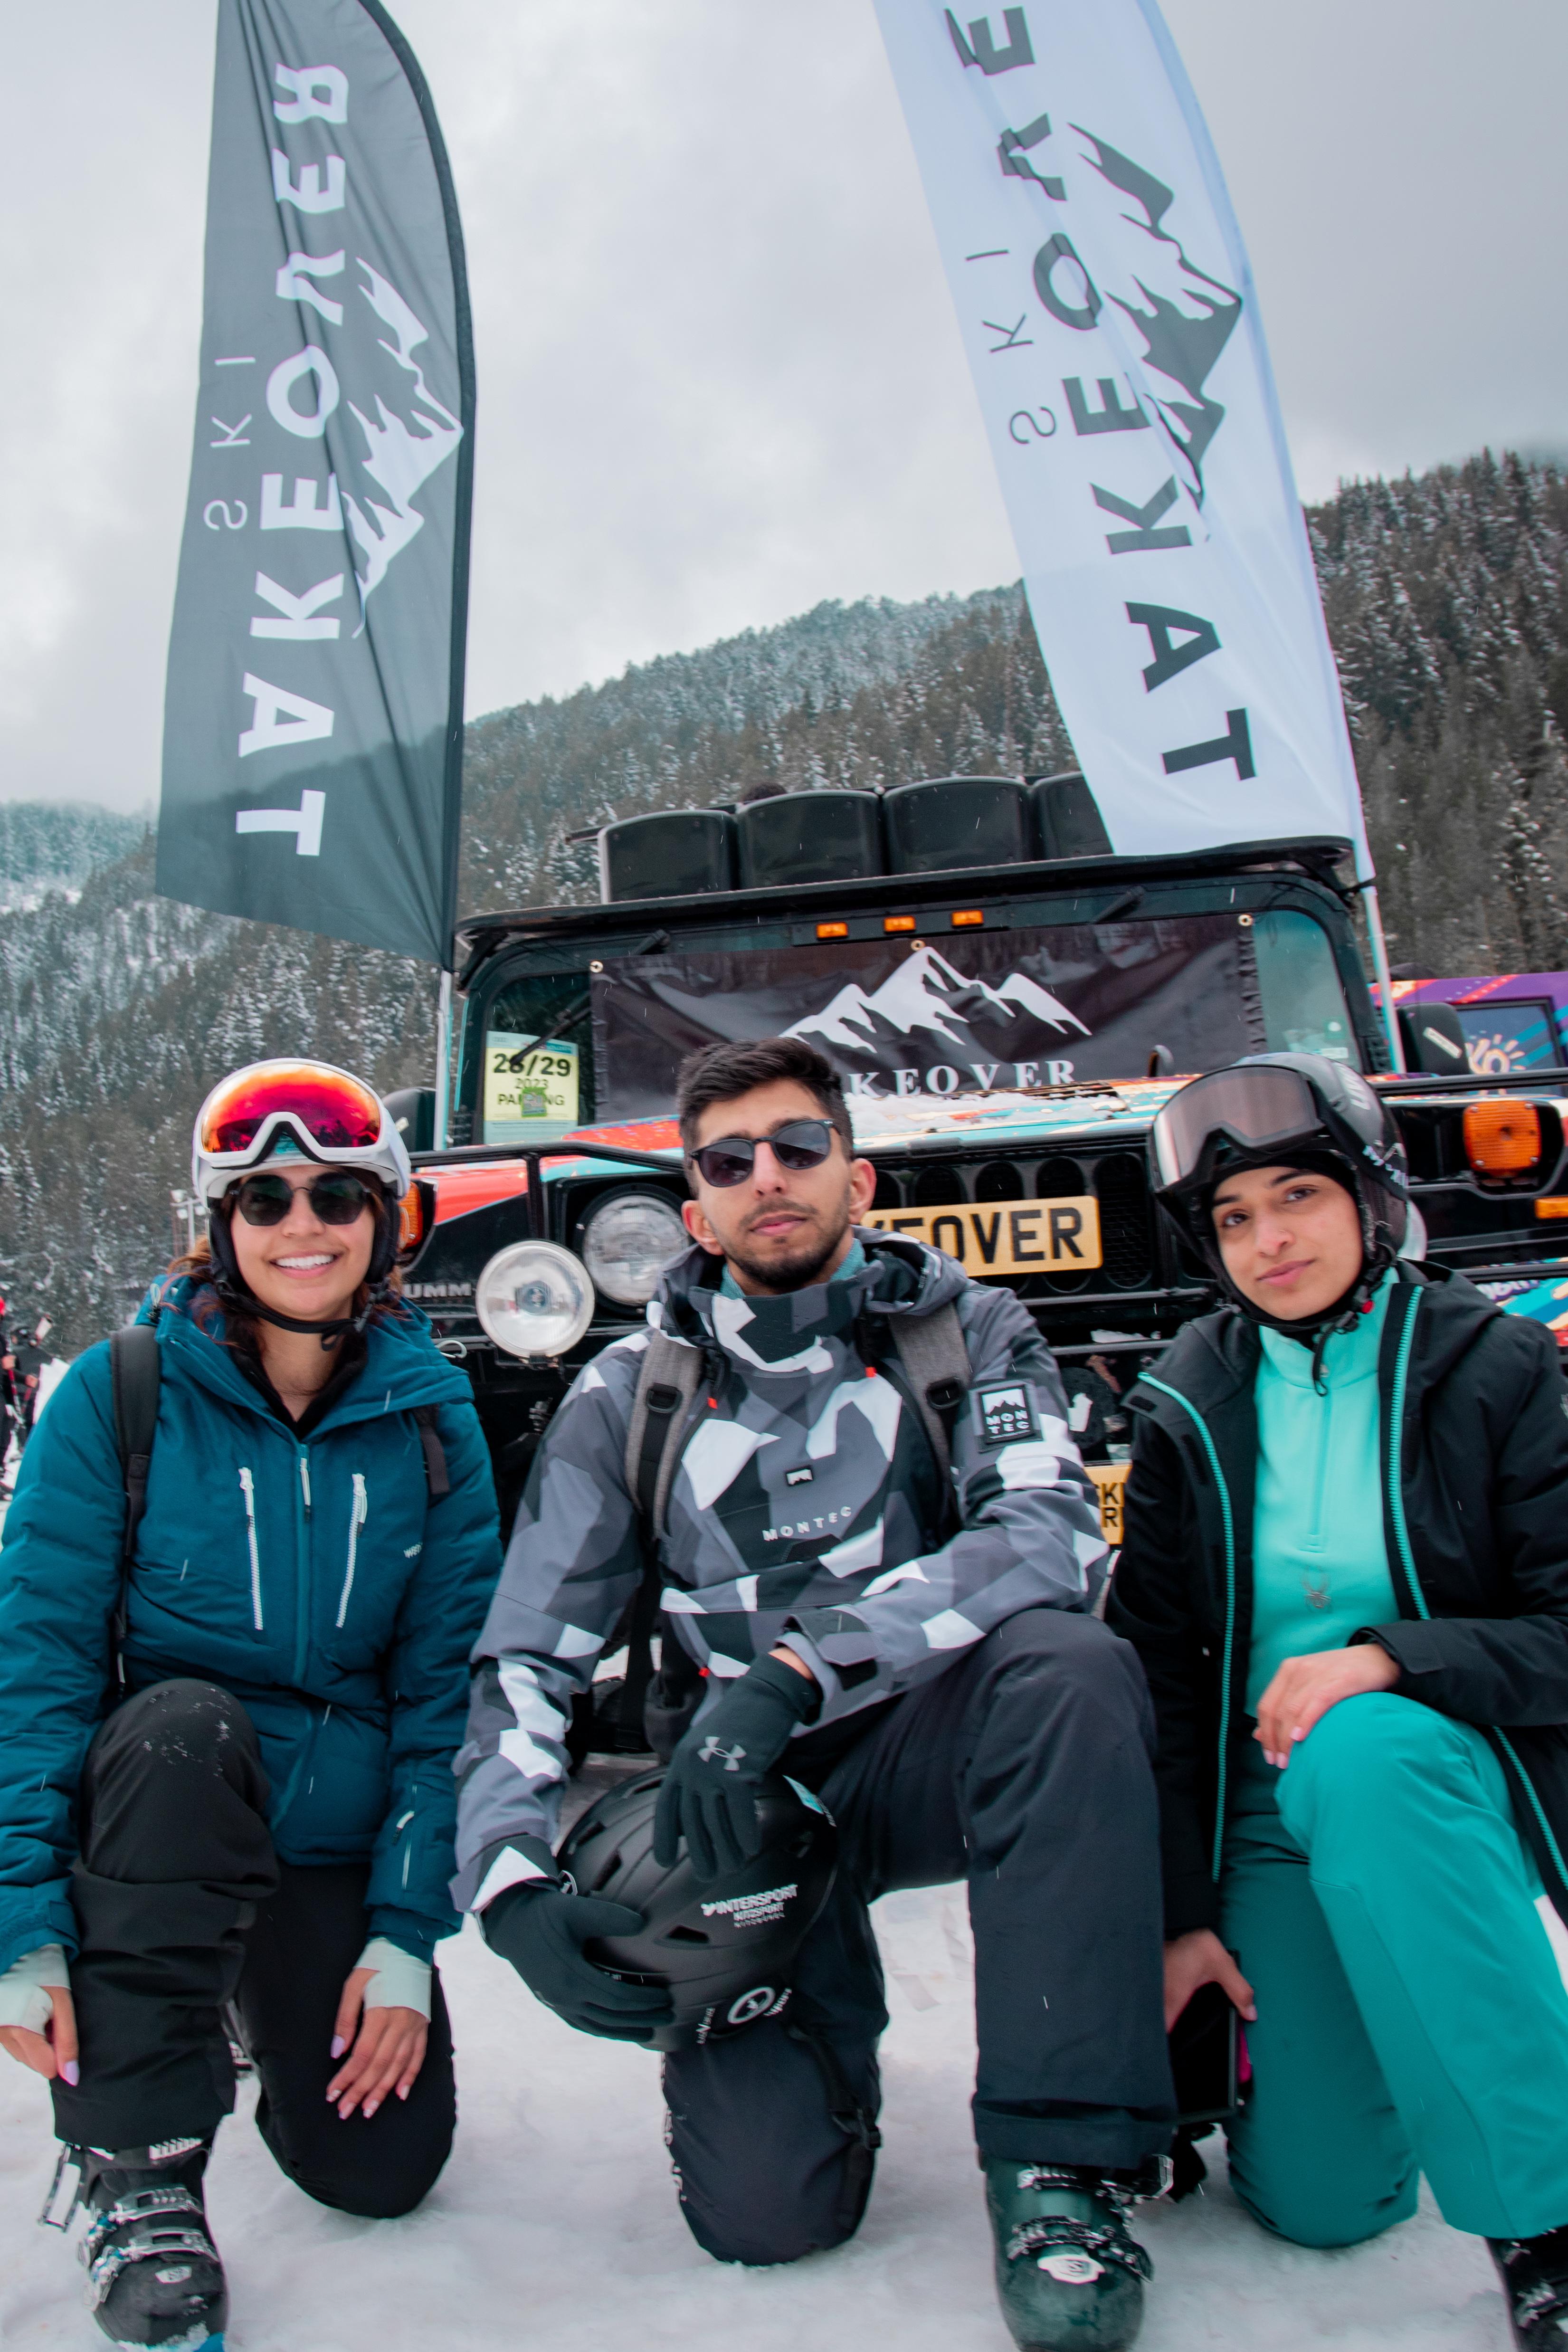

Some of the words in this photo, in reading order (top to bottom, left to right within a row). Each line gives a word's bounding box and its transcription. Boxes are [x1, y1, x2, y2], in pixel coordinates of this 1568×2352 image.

[515, 1078, 548, 1089] 2023
[498, 1094, 564, 1105] PANG
[985, 1409, 1028, 1425] MON
[988, 1421, 1030, 1434] TEC
[762, 1505, 852, 1541] MONTEC
[715, 1884, 798, 1914] INTERSPORT
